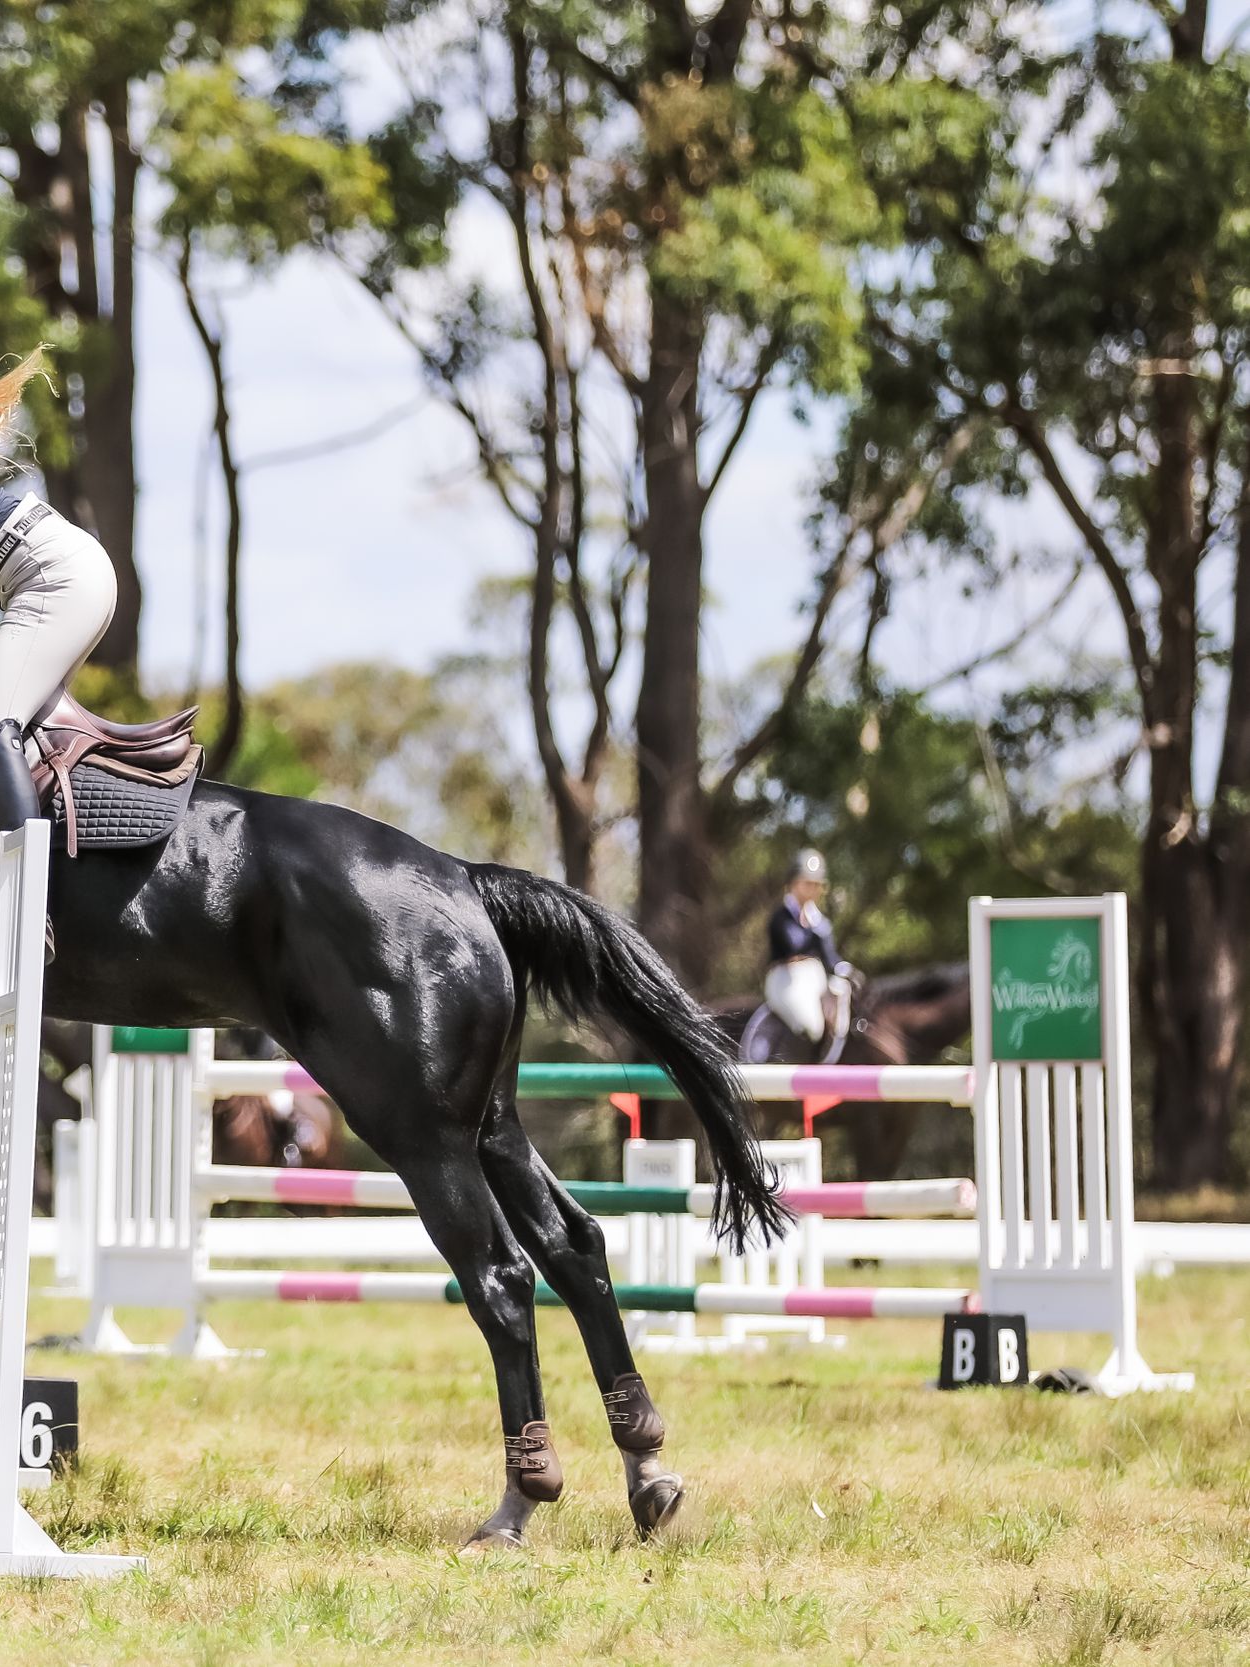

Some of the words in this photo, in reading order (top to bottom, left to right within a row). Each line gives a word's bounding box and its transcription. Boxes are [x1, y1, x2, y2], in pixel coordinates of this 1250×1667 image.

[952, 1328, 976, 1382] B
[998, 1328, 1020, 1383] B
[21, 1402, 54, 1468] 6
